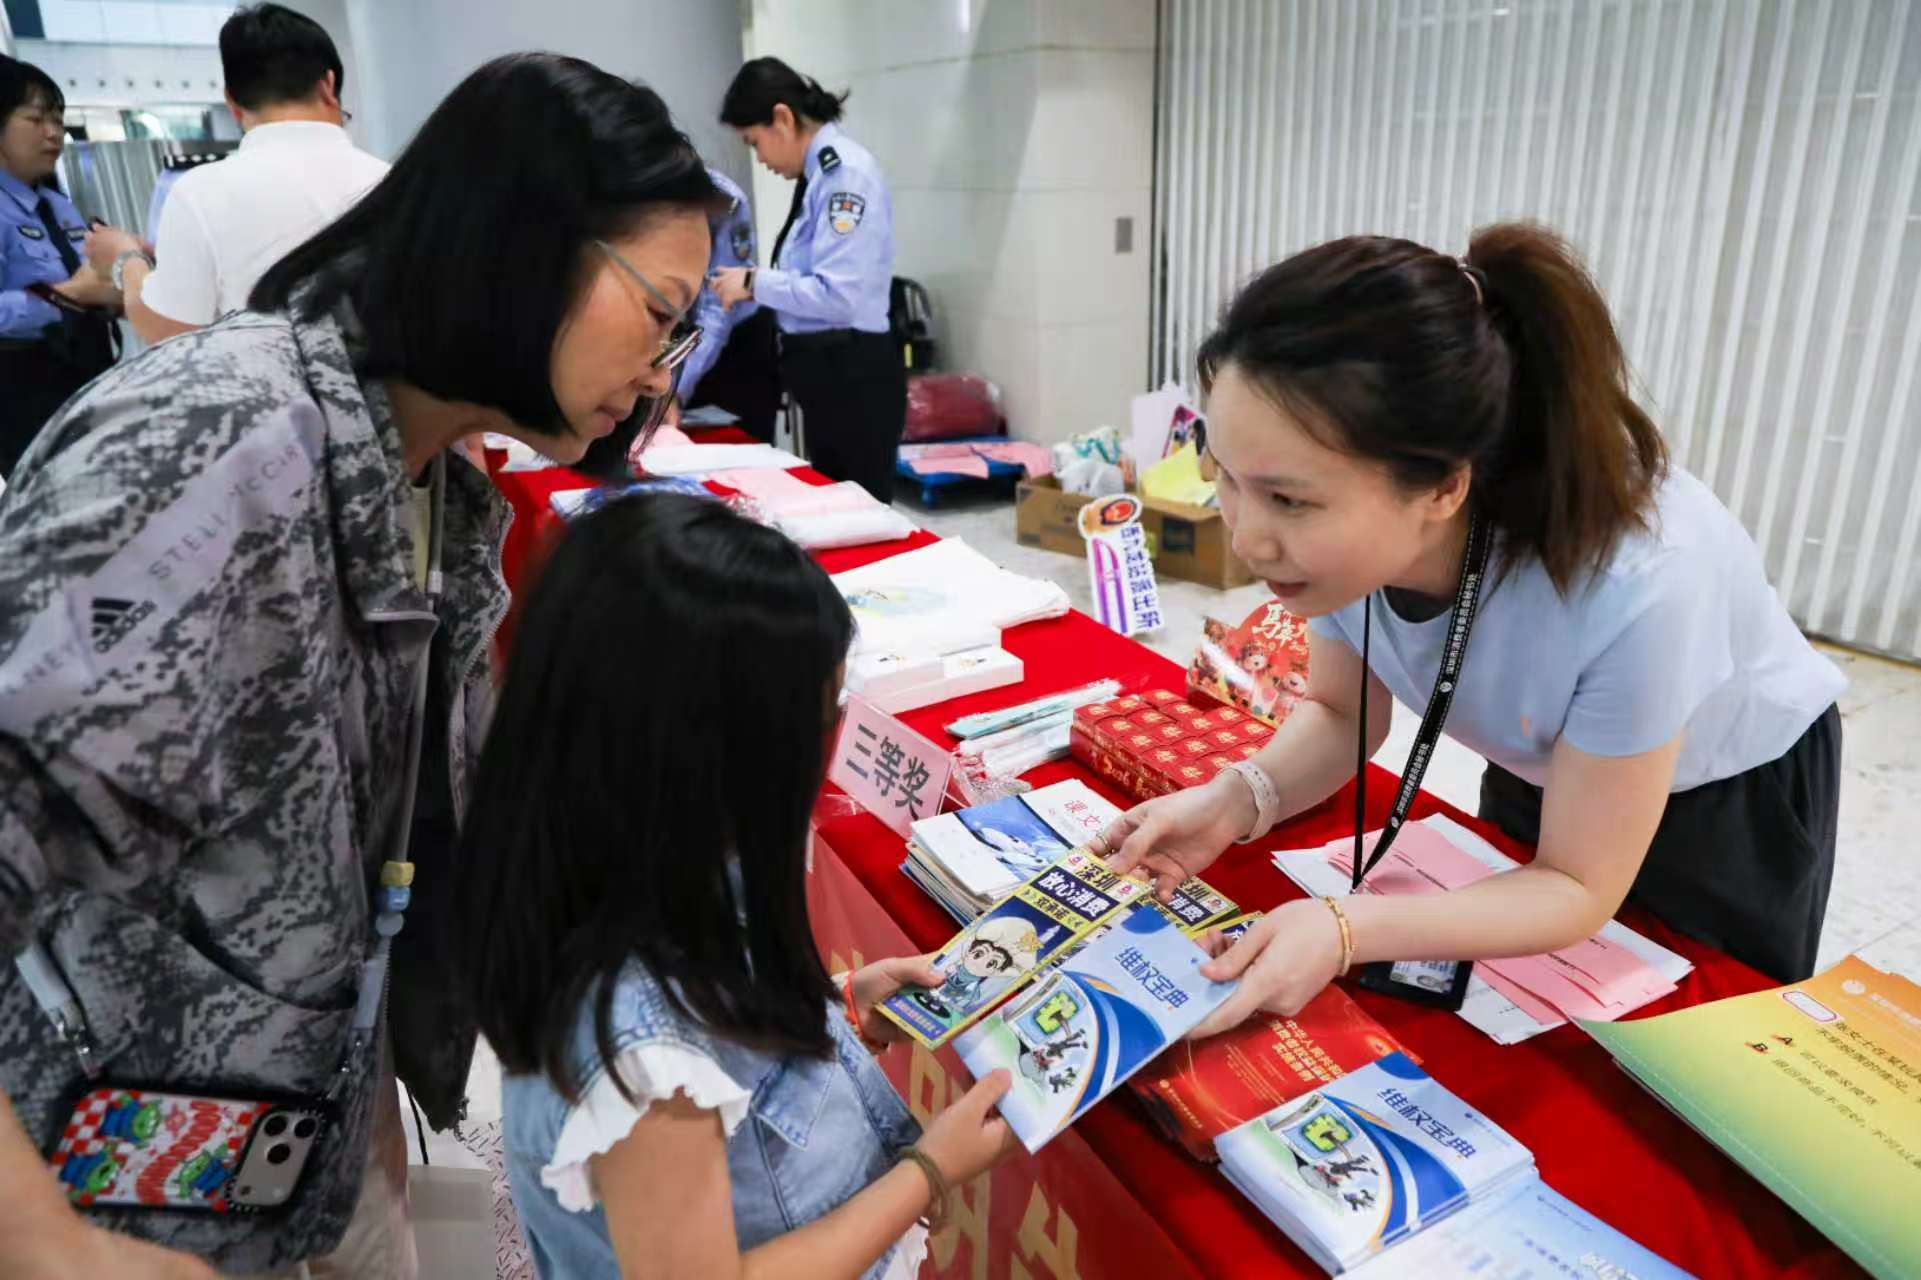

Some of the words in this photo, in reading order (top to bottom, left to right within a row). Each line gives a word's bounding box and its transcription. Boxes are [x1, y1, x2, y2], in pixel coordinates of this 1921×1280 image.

[93, 600, 157, 653] adidas
[846, 722, 930, 821] 三等奖
[1037, 871, 1111, 917] 放心消费
[1075, 863, 1121, 892] 深圳
[1114, 946, 1190, 1009] 维权宝典
[1377, 1088, 1477, 1158] 维权宝典
